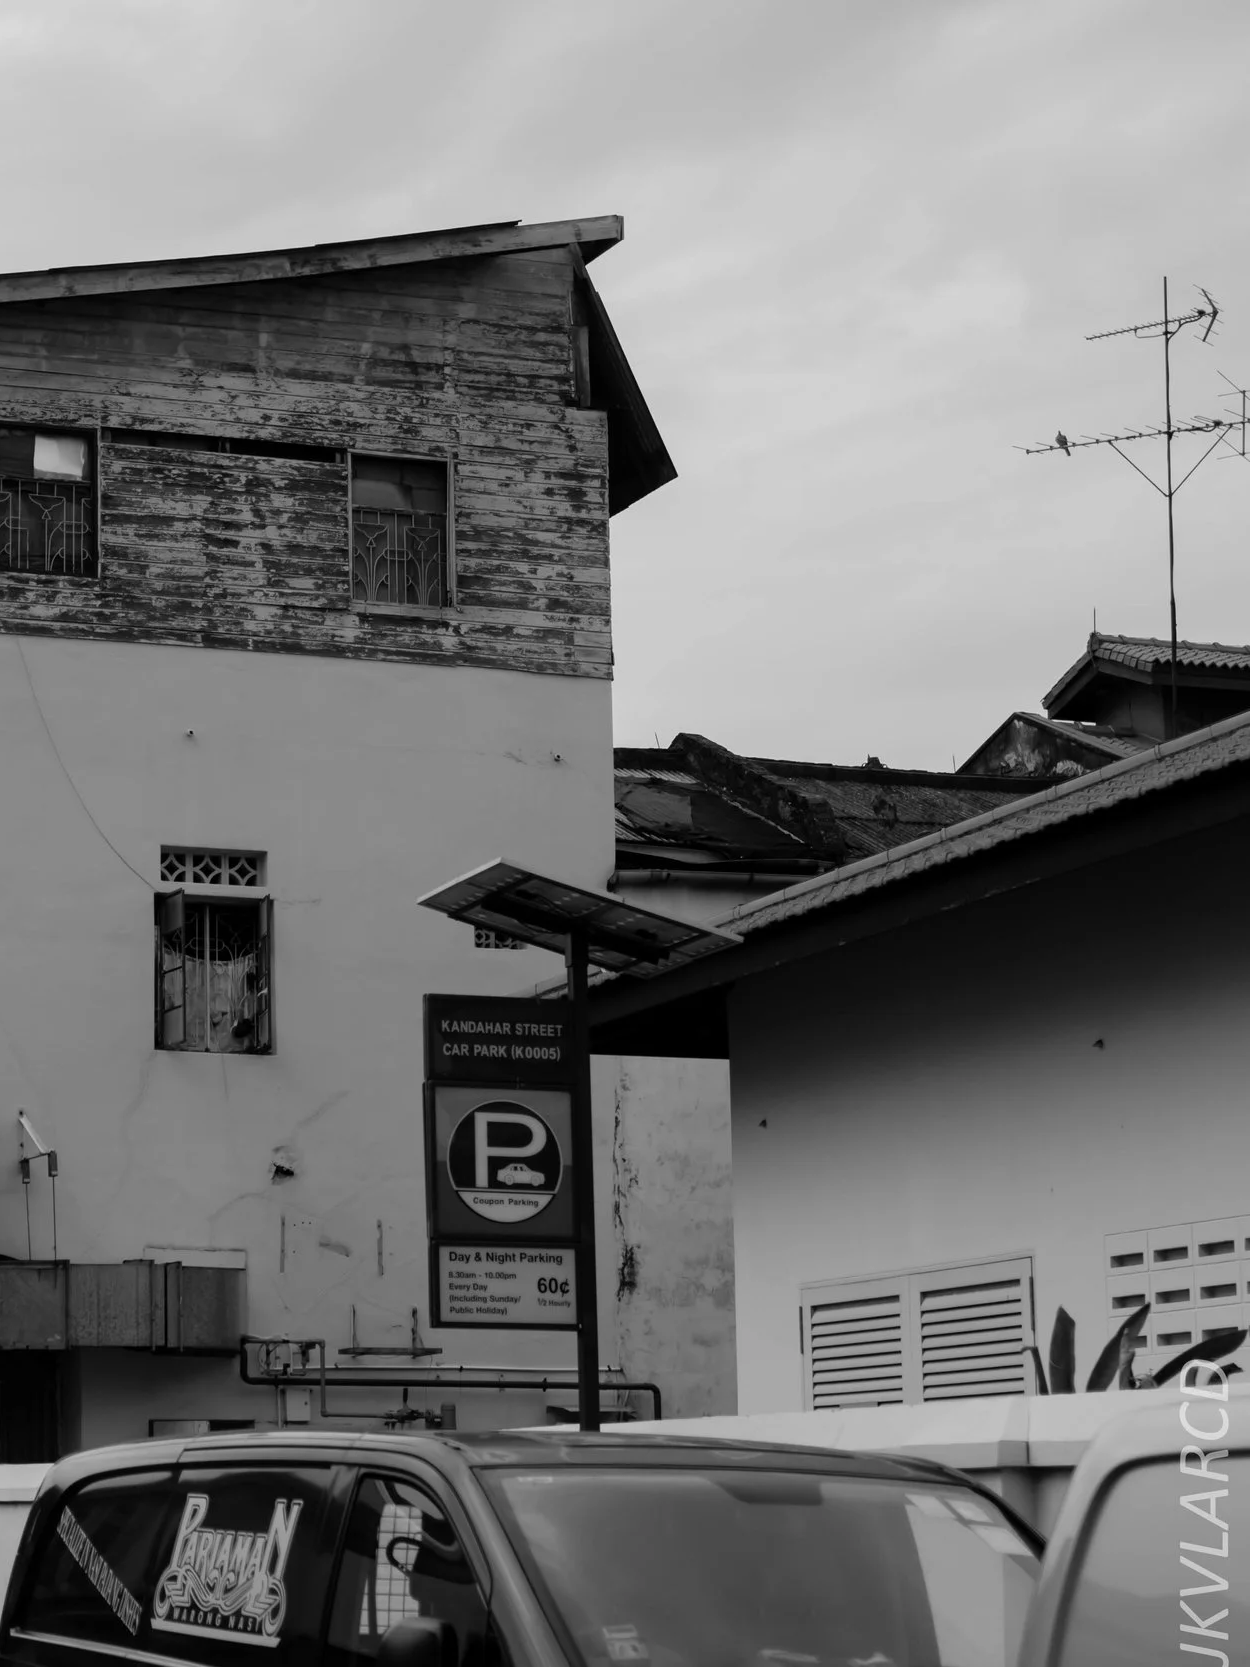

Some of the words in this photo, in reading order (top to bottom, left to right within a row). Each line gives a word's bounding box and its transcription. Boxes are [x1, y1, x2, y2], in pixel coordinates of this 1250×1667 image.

[441, 1020, 512, 1035] KANDAHAR
[515, 1023, 563, 1037] STREET
[442, 1043, 470, 1056] CAR
[473, 1044, 508, 1058] PARK
[511, 1044, 561, 1062] (K0005)
[473, 1111, 548, 1188] P
[473, 1197, 505, 1206] Coupon
[508, 1198, 539, 1208] Parking
[449, 1251, 471, 1264] Day
[474, 1252, 482, 1262] &
[486, 1252, 517, 1265] Night
[519, 1253, 563, 1266] Parking
[448, 1271, 477, 1279] 8.30am
[485, 1272, 517, 1280] 10.00pm
[449, 1283, 471, 1291] Every
[472, 1283, 488, 1291] Day
[449, 1295, 488, 1304] (Including
[548, 1299, 571, 1308] Hourly
[449, 1306, 474, 1314] Public
[476, 1307, 508, 1316] Holiday)
[169, 1492, 304, 1585] PARIAMAN
[173, 1607, 222, 1627] WARONG
[228, 1616, 261, 1633] NASI
